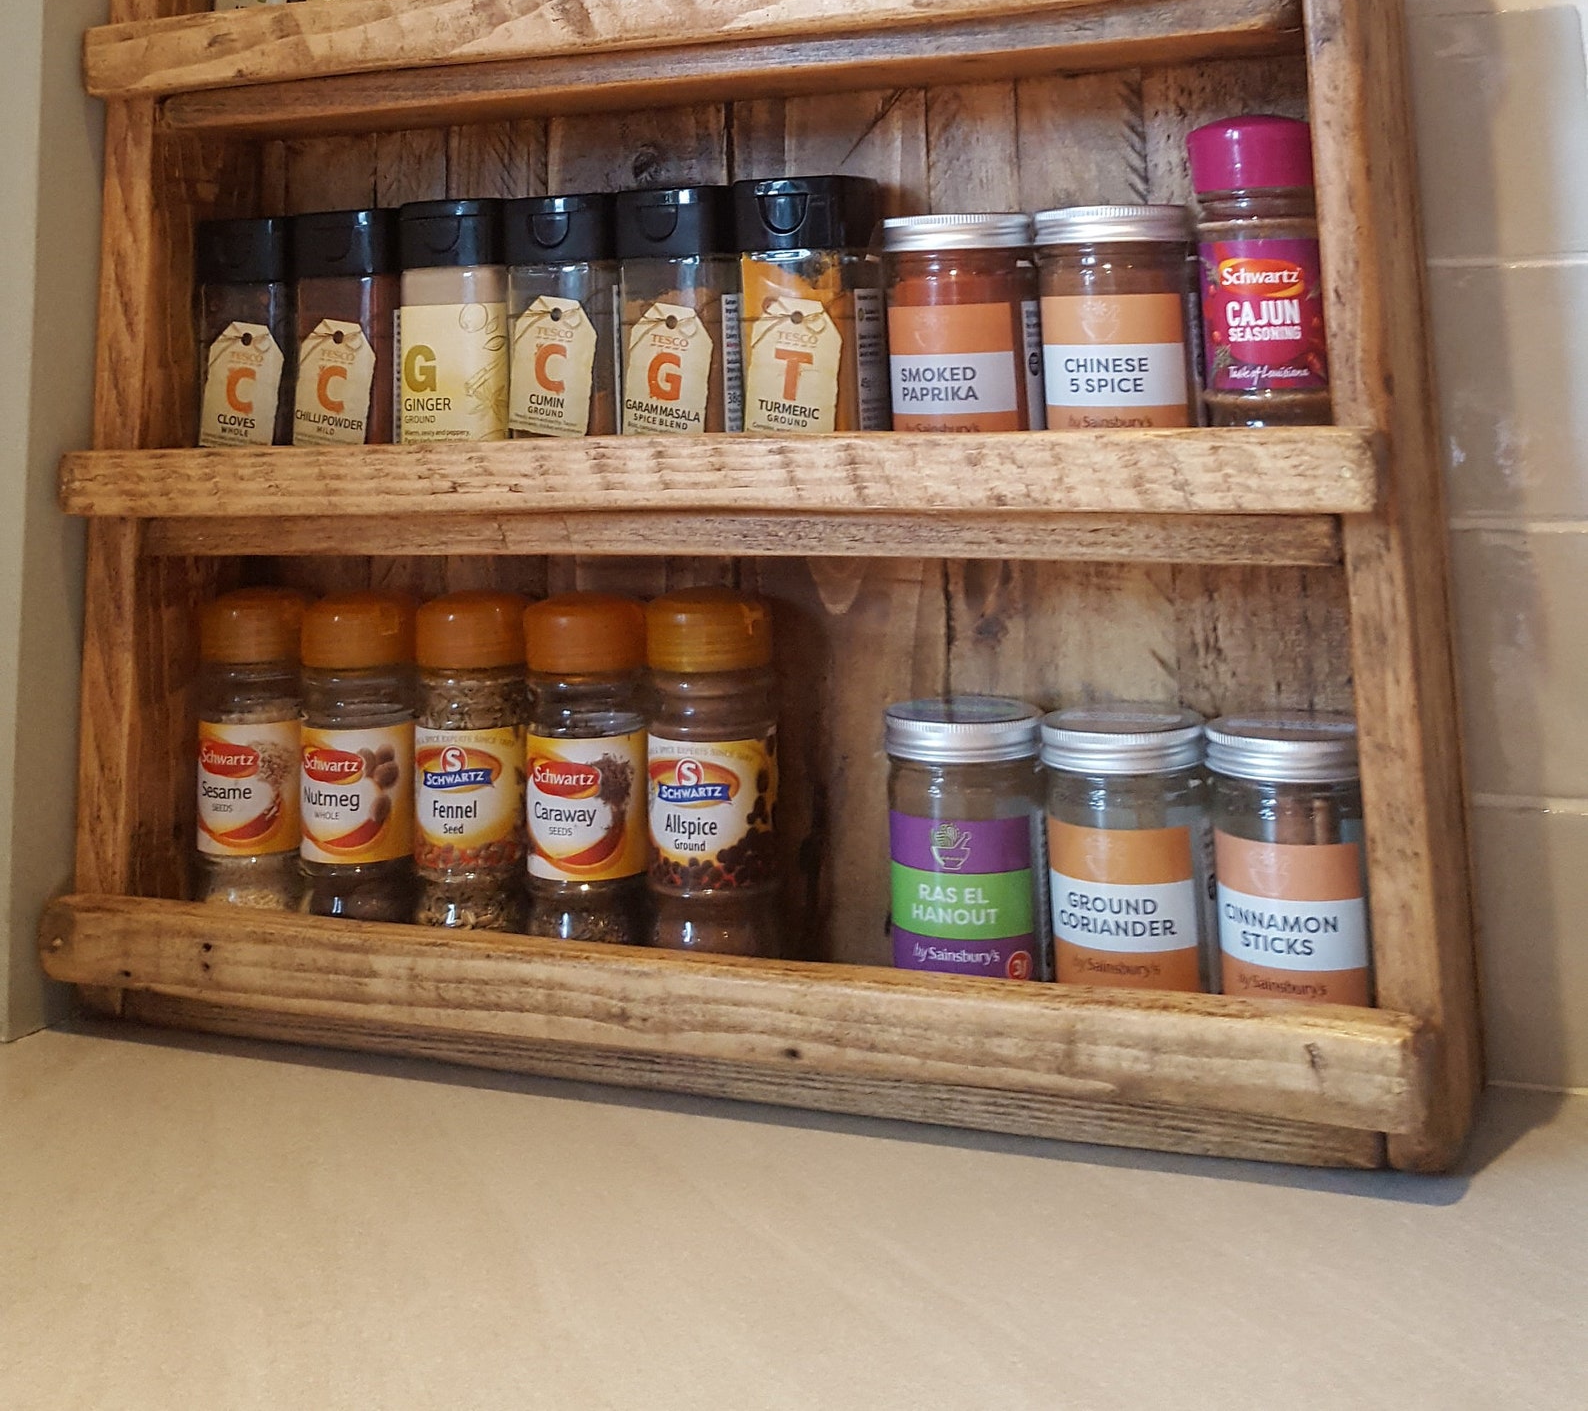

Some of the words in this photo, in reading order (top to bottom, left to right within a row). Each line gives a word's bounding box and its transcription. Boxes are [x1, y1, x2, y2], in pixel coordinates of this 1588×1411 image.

[1220, 266, 1301, 287] Schwartz
[1225, 298, 1302, 328] CAJUN
[536, 325, 574, 339] TESCO
[650, 333, 689, 347] TESCO
[777, 331, 819, 345] TESCO
[1227, 325, 1302, 342] SEASONING
[403, 344, 437, 393] G
[534, 341, 568, 395] C
[774, 347, 814, 401] T
[1063, 357, 1150, 374] CHINESE
[647, 351, 682, 402] G
[901, 366, 977, 384] SMOKED
[226, 366, 257, 414] C
[317, 365, 348, 414] C
[902, 385, 979, 402] PAPRIKA
[1069, 378, 1081, 393] 5
[1084, 378, 1145, 394] SPICE
[404, 397, 452, 412] GINGER
[529, 393, 565, 409] CUMIN
[758, 398, 820, 421] TURMERIC
[295, 409, 322, 424] CHILLI
[321, 413, 364, 431] POWDER
[404, 415, 436, 424] GROUND
[527, 405, 564, 419] GROUND
[625, 398, 659, 415] GARAM
[659, 406, 701, 424] MASALA
[217, 413, 256, 429] CLOVES
[633, 413, 657, 425] SPICE
[659, 418, 689, 431] BLEND
[766, 413, 808, 428] GROUND
[220, 426, 249, 437] WHOLE
[316, 426, 335, 436] MILD
[202, 747, 255, 766] Schwartz
[303, 755, 360, 773] Schwartz
[426, 771, 485, 786] SCHWARTZ
[534, 766, 595, 786] Schwartz
[202, 782, 253, 800] Sesame
[303, 788, 361, 812] Nutmeg
[661, 785, 722, 799] SCHWARTZ
[211, 803, 234, 813] SEEDS
[313, 810, 341, 820] WHOLE
[432, 799, 478, 819] Fennel
[534, 801, 597, 826] Caraway
[443, 823, 464, 835] Seed
[548, 826, 574, 836] SEEDS
[665, 814, 718, 839] Allspice
[674, 839, 706, 852] Ground
[918, 883, 958, 904] RAS
[963, 887, 990, 904] EL
[1068, 891, 1158, 915] GROUND
[911, 903, 998, 926] HANOUT
[1059, 908, 1178, 937] CORIANDER
[1225, 902, 1340, 934] CINNAMON
[1240, 930, 1315, 957] STICKS
[927, 946, 1000, 966] Sainsbury's
